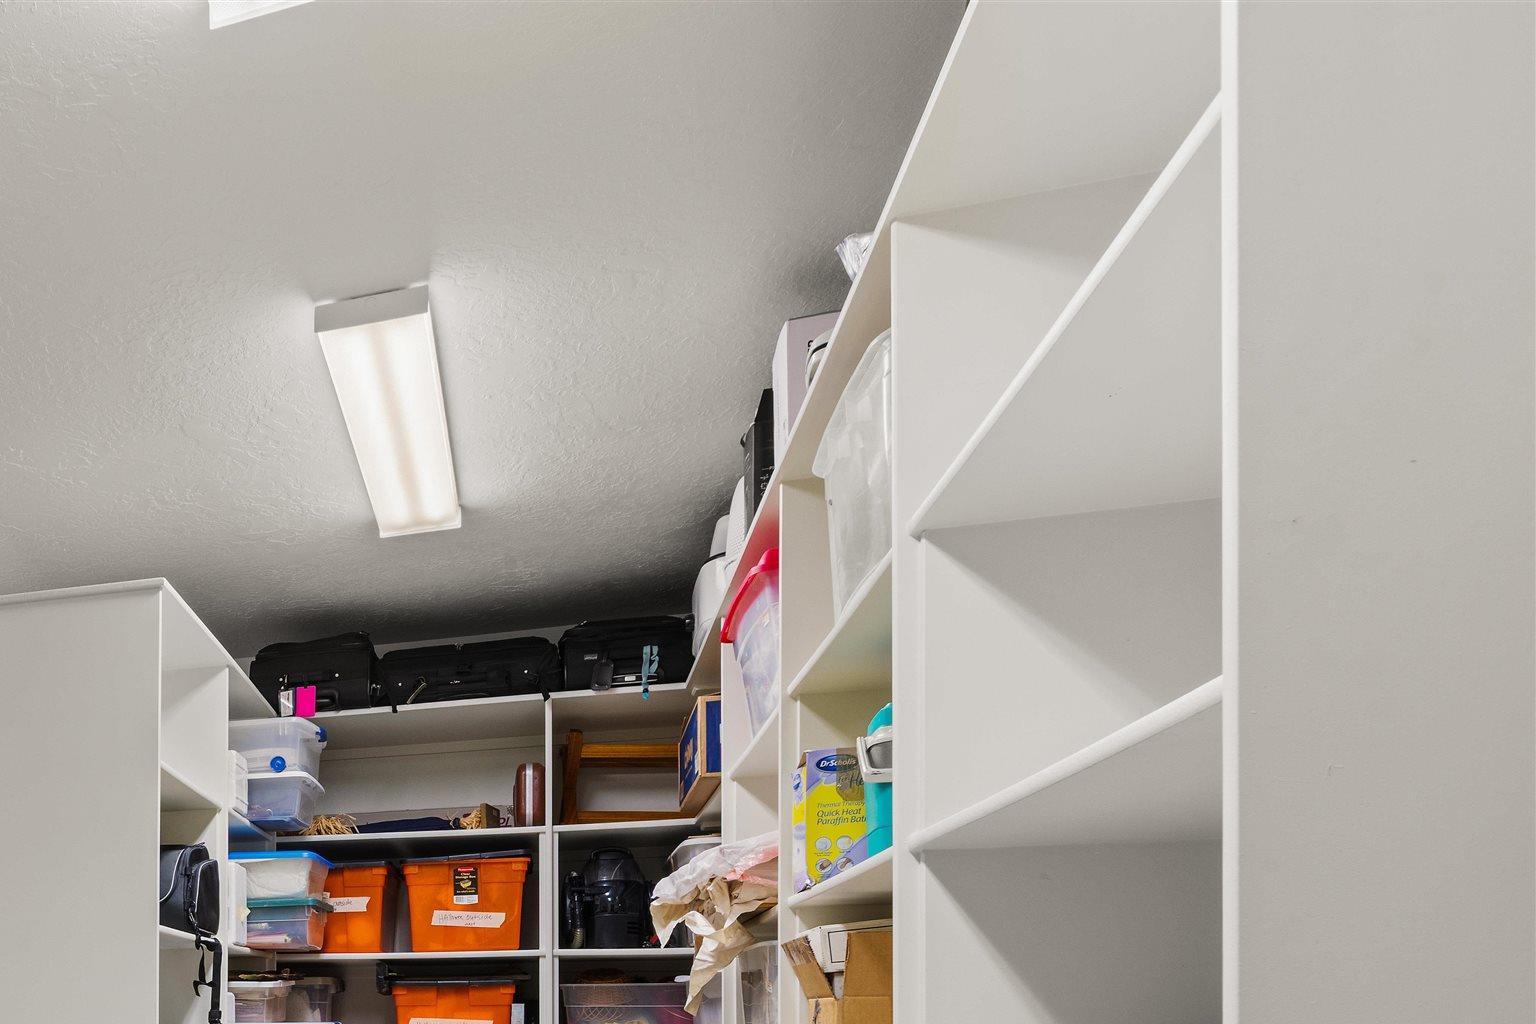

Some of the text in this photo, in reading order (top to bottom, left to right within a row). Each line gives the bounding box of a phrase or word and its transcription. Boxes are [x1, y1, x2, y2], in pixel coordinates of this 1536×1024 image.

[816, 808, 862, 818] Quick Heat
[816, 816, 849, 826] Paraffin
